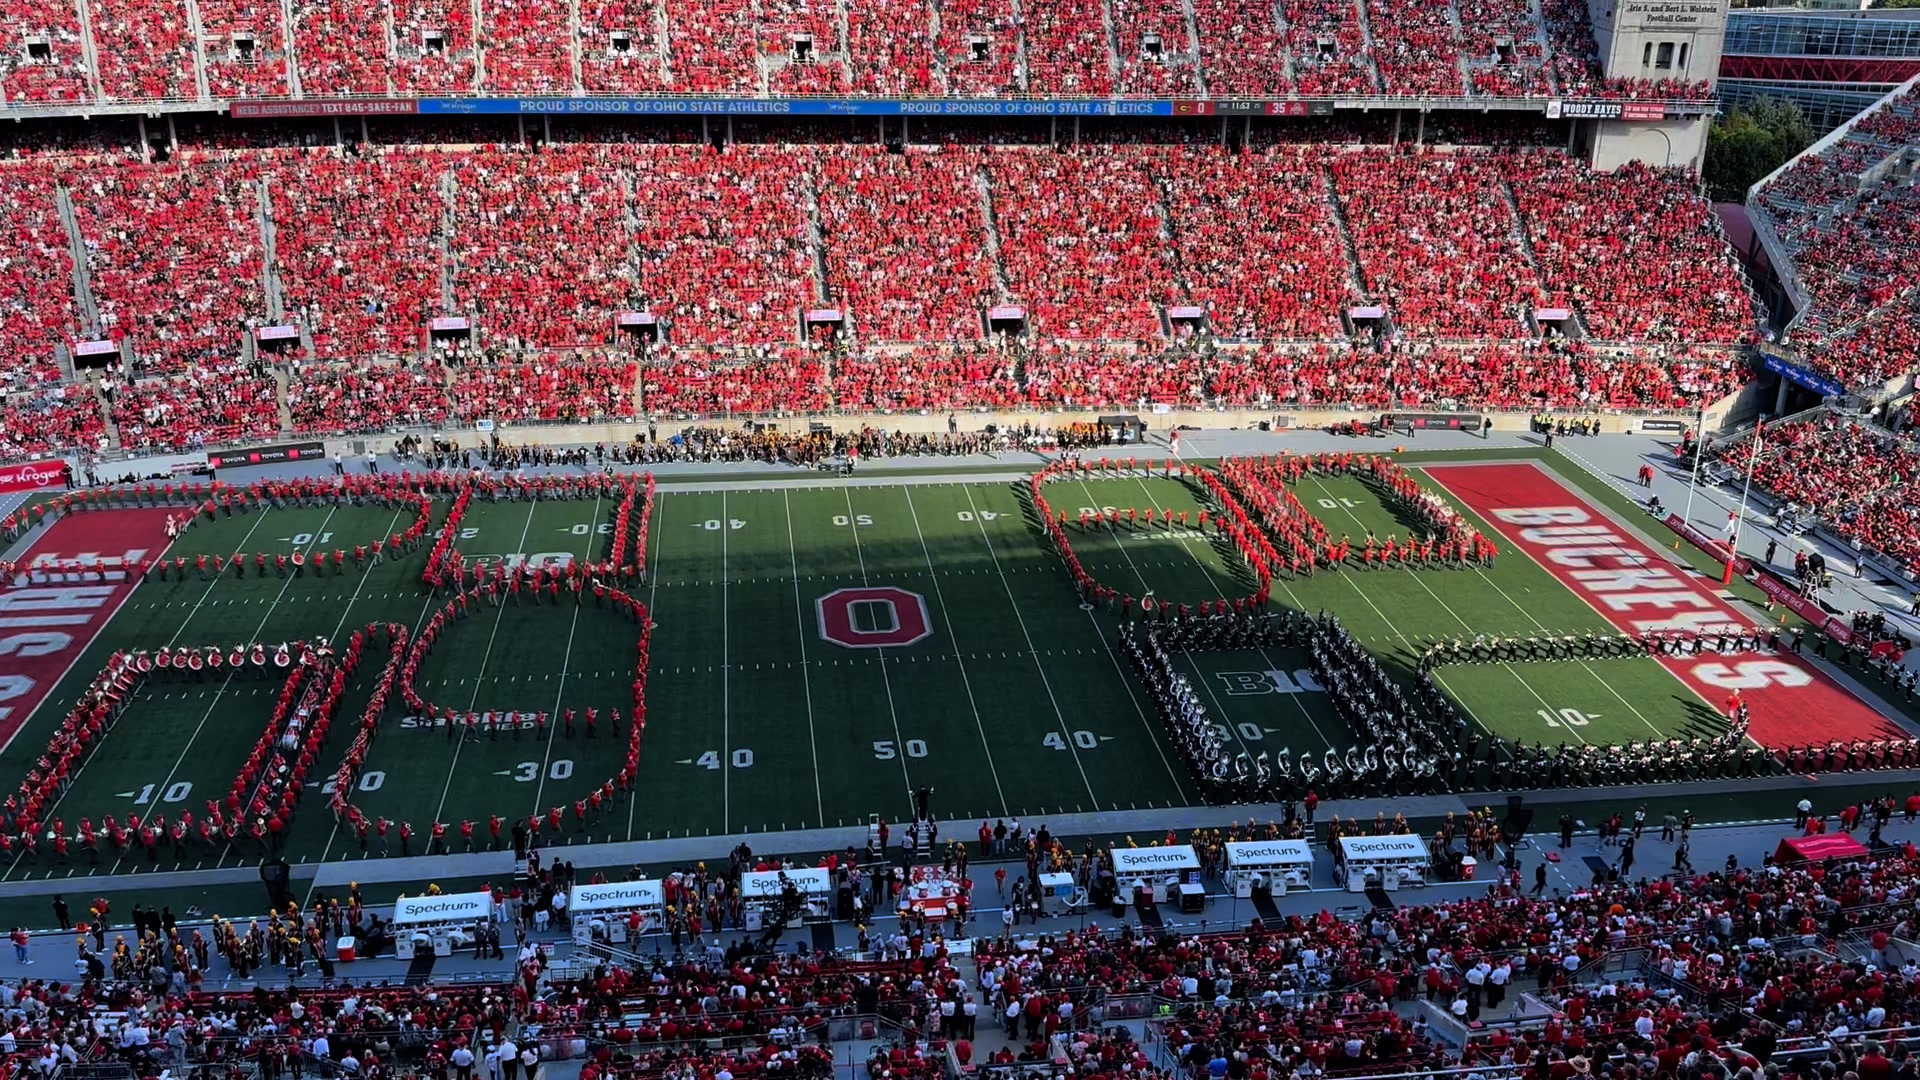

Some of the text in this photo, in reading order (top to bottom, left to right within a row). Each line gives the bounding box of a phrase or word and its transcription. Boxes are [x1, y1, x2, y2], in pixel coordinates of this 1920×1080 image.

[1647, 14, 1673, 22] Football
[237, 105, 259, 115] NEED
[262, 104, 320, 115] ASSISTANCE?
[321, 103, 343, 113] TEXT
[520, 101, 790, 112] PROUD SPONSOR OF OHIO STATE ATHLETICS
[901, 102, 941, 113] PROUD
[945, 102, 1001, 113] SPONSOR
[1005, 102, 1021, 113] OF
[1023, 102, 1055, 113] OHIO
[1058, 102, 1091, 113] STATE
[1272, 102, 1286, 114] 35
[1562, 103, 1592, 113] WOODY
[1594, 103, 1621, 114] HAYES
[300, 448, 323, 456] TOYOTA
[16, 466, 61, 486] Kroger
[1761, 578, 1804, 611] DEFEND THE SHOE
[814, 586, 934, 648] O
[1537, 708, 1589, 727] 10
[1042, 730, 1098, 750] 40
[873, 739, 930, 760] 50
[696, 748, 755, 770] 40
[514, 759, 574, 782] 30
[134, 782, 193, 804] 10
[1236, 846, 1297, 859] Spectrum
[1350, 842, 1410, 853] Spectrum
[1122, 852, 1183, 866] Spectrum
[580, 889, 646, 902] Spectrum
[405, 901, 473, 916] Spectrum
